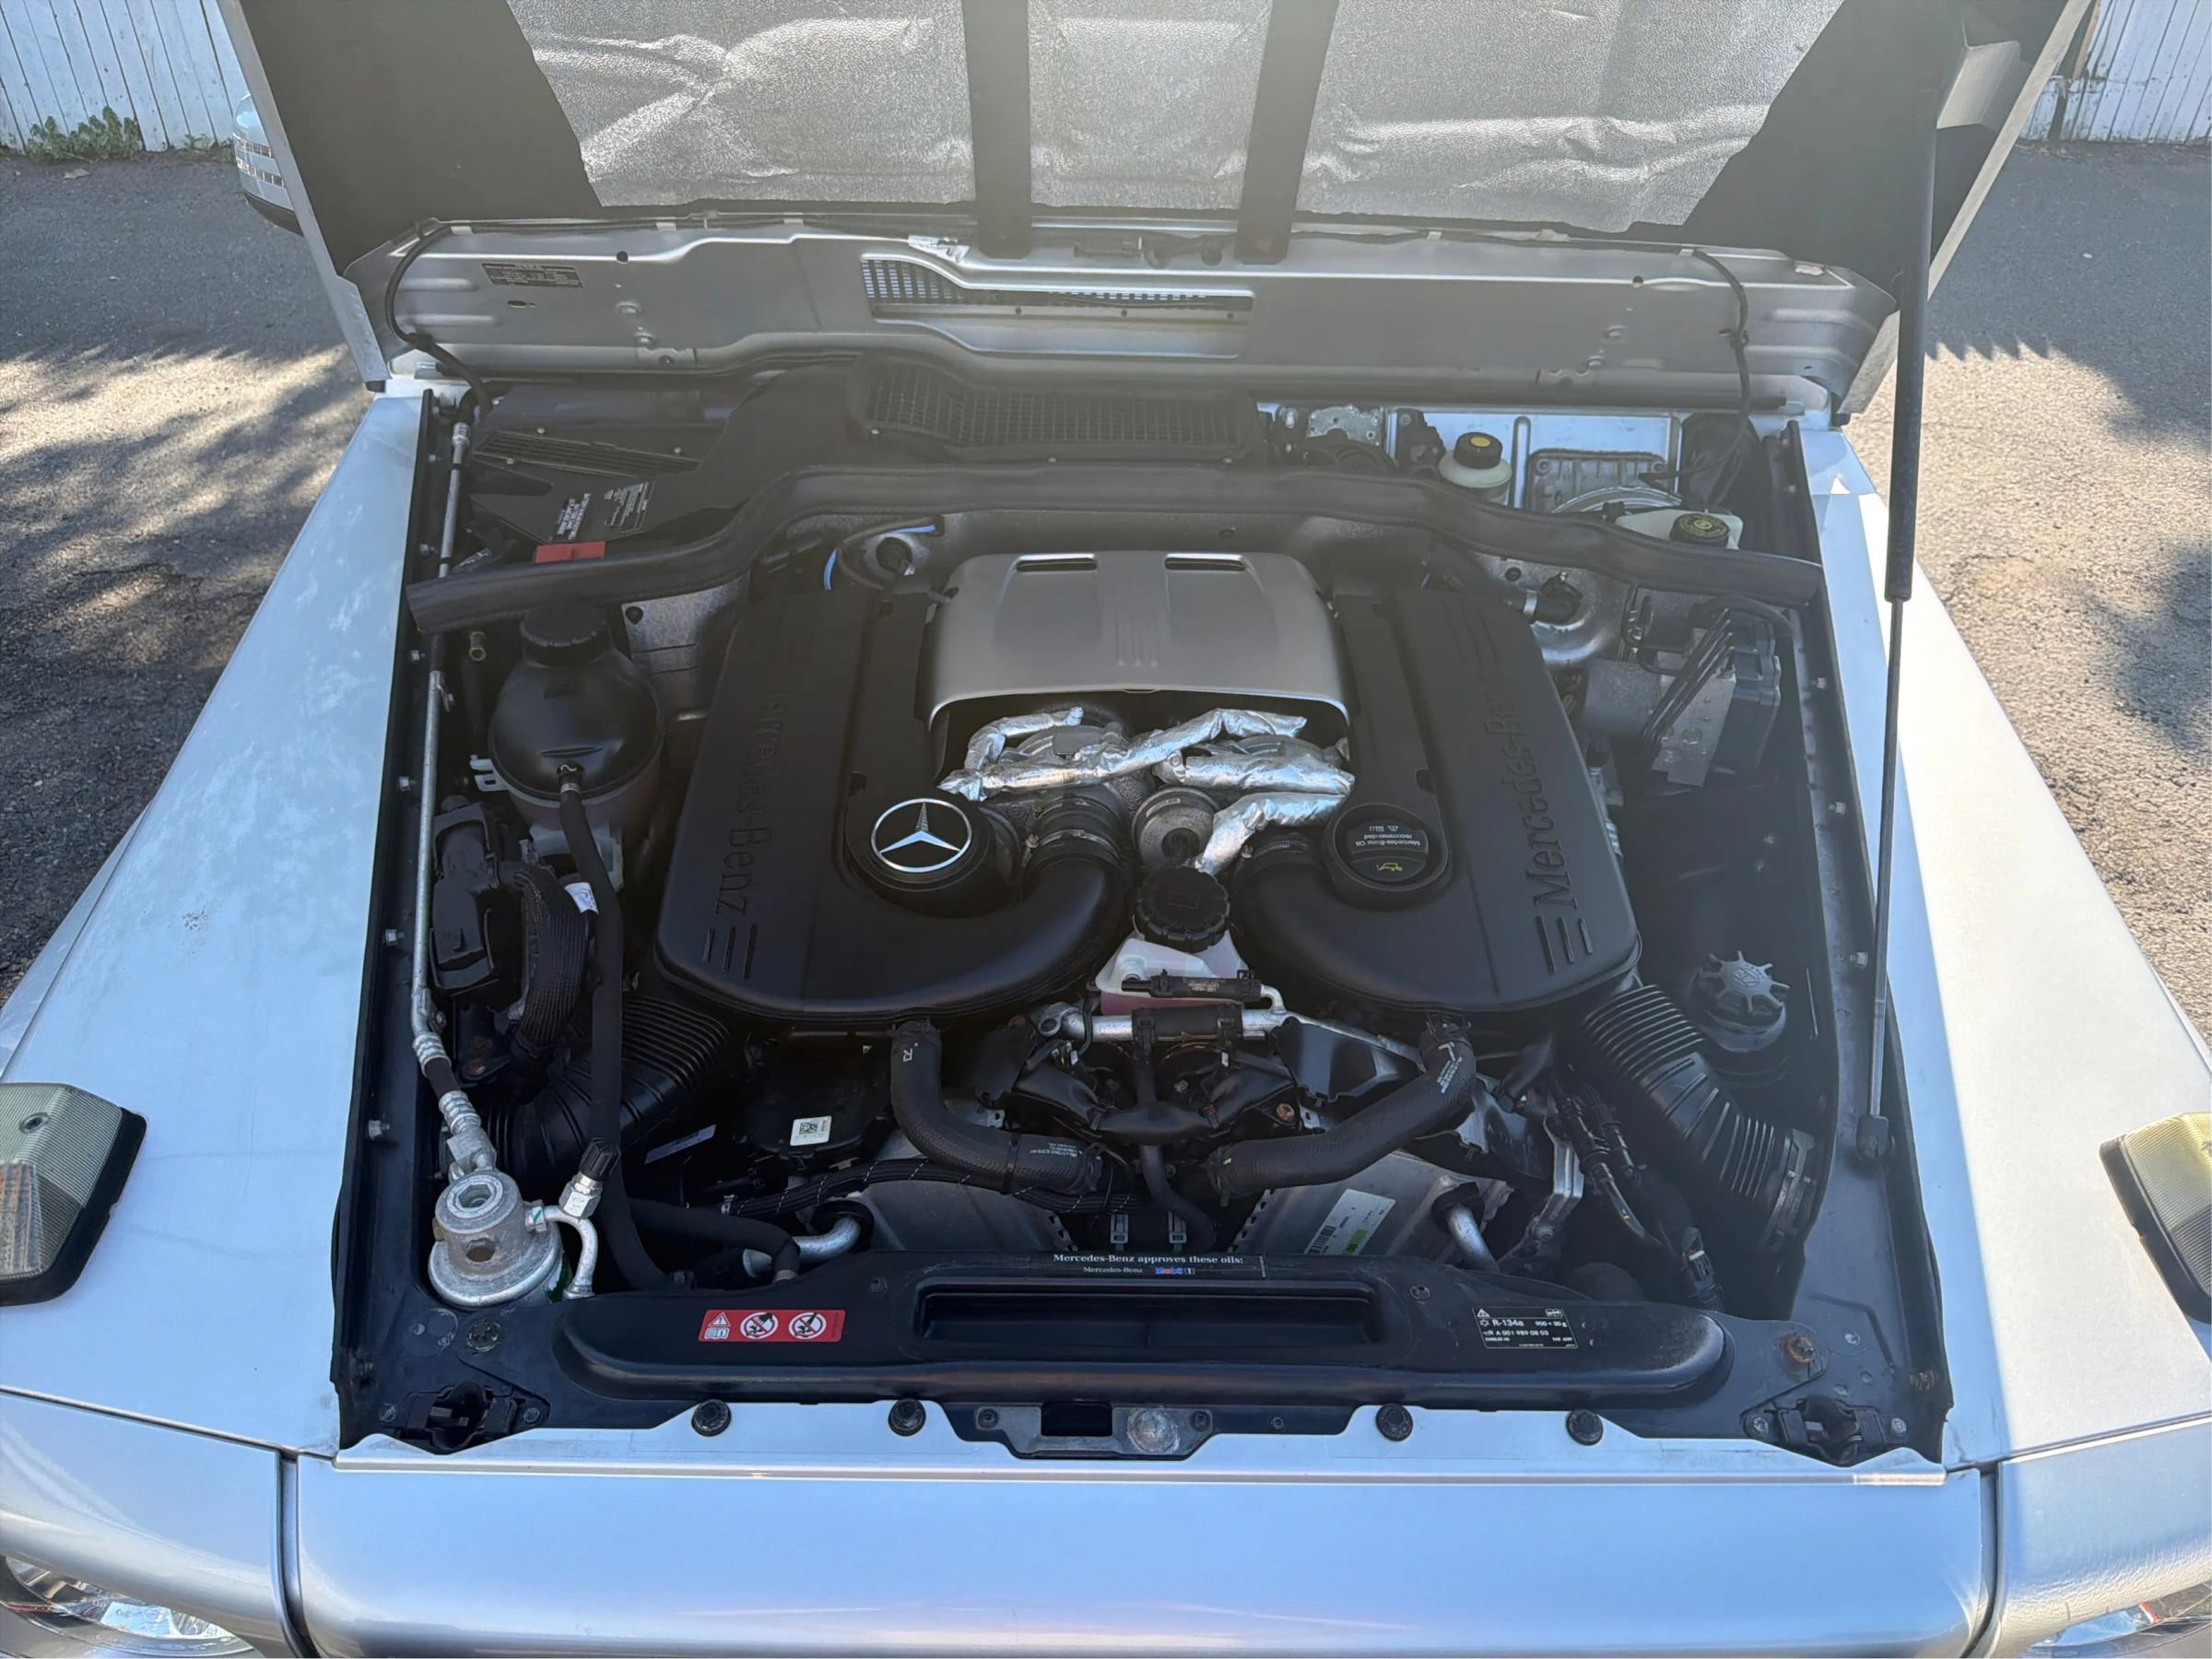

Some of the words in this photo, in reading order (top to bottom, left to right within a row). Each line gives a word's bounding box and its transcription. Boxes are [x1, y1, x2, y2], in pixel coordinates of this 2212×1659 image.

[1483, 687, 1577, 910] Mercedes-Ben
[1053, 1254, 1135, 1263] Mercedes-Benz
[1137, 1255, 1186, 1264] approves
[1491, 1319, 1524, 1327] R-134a
